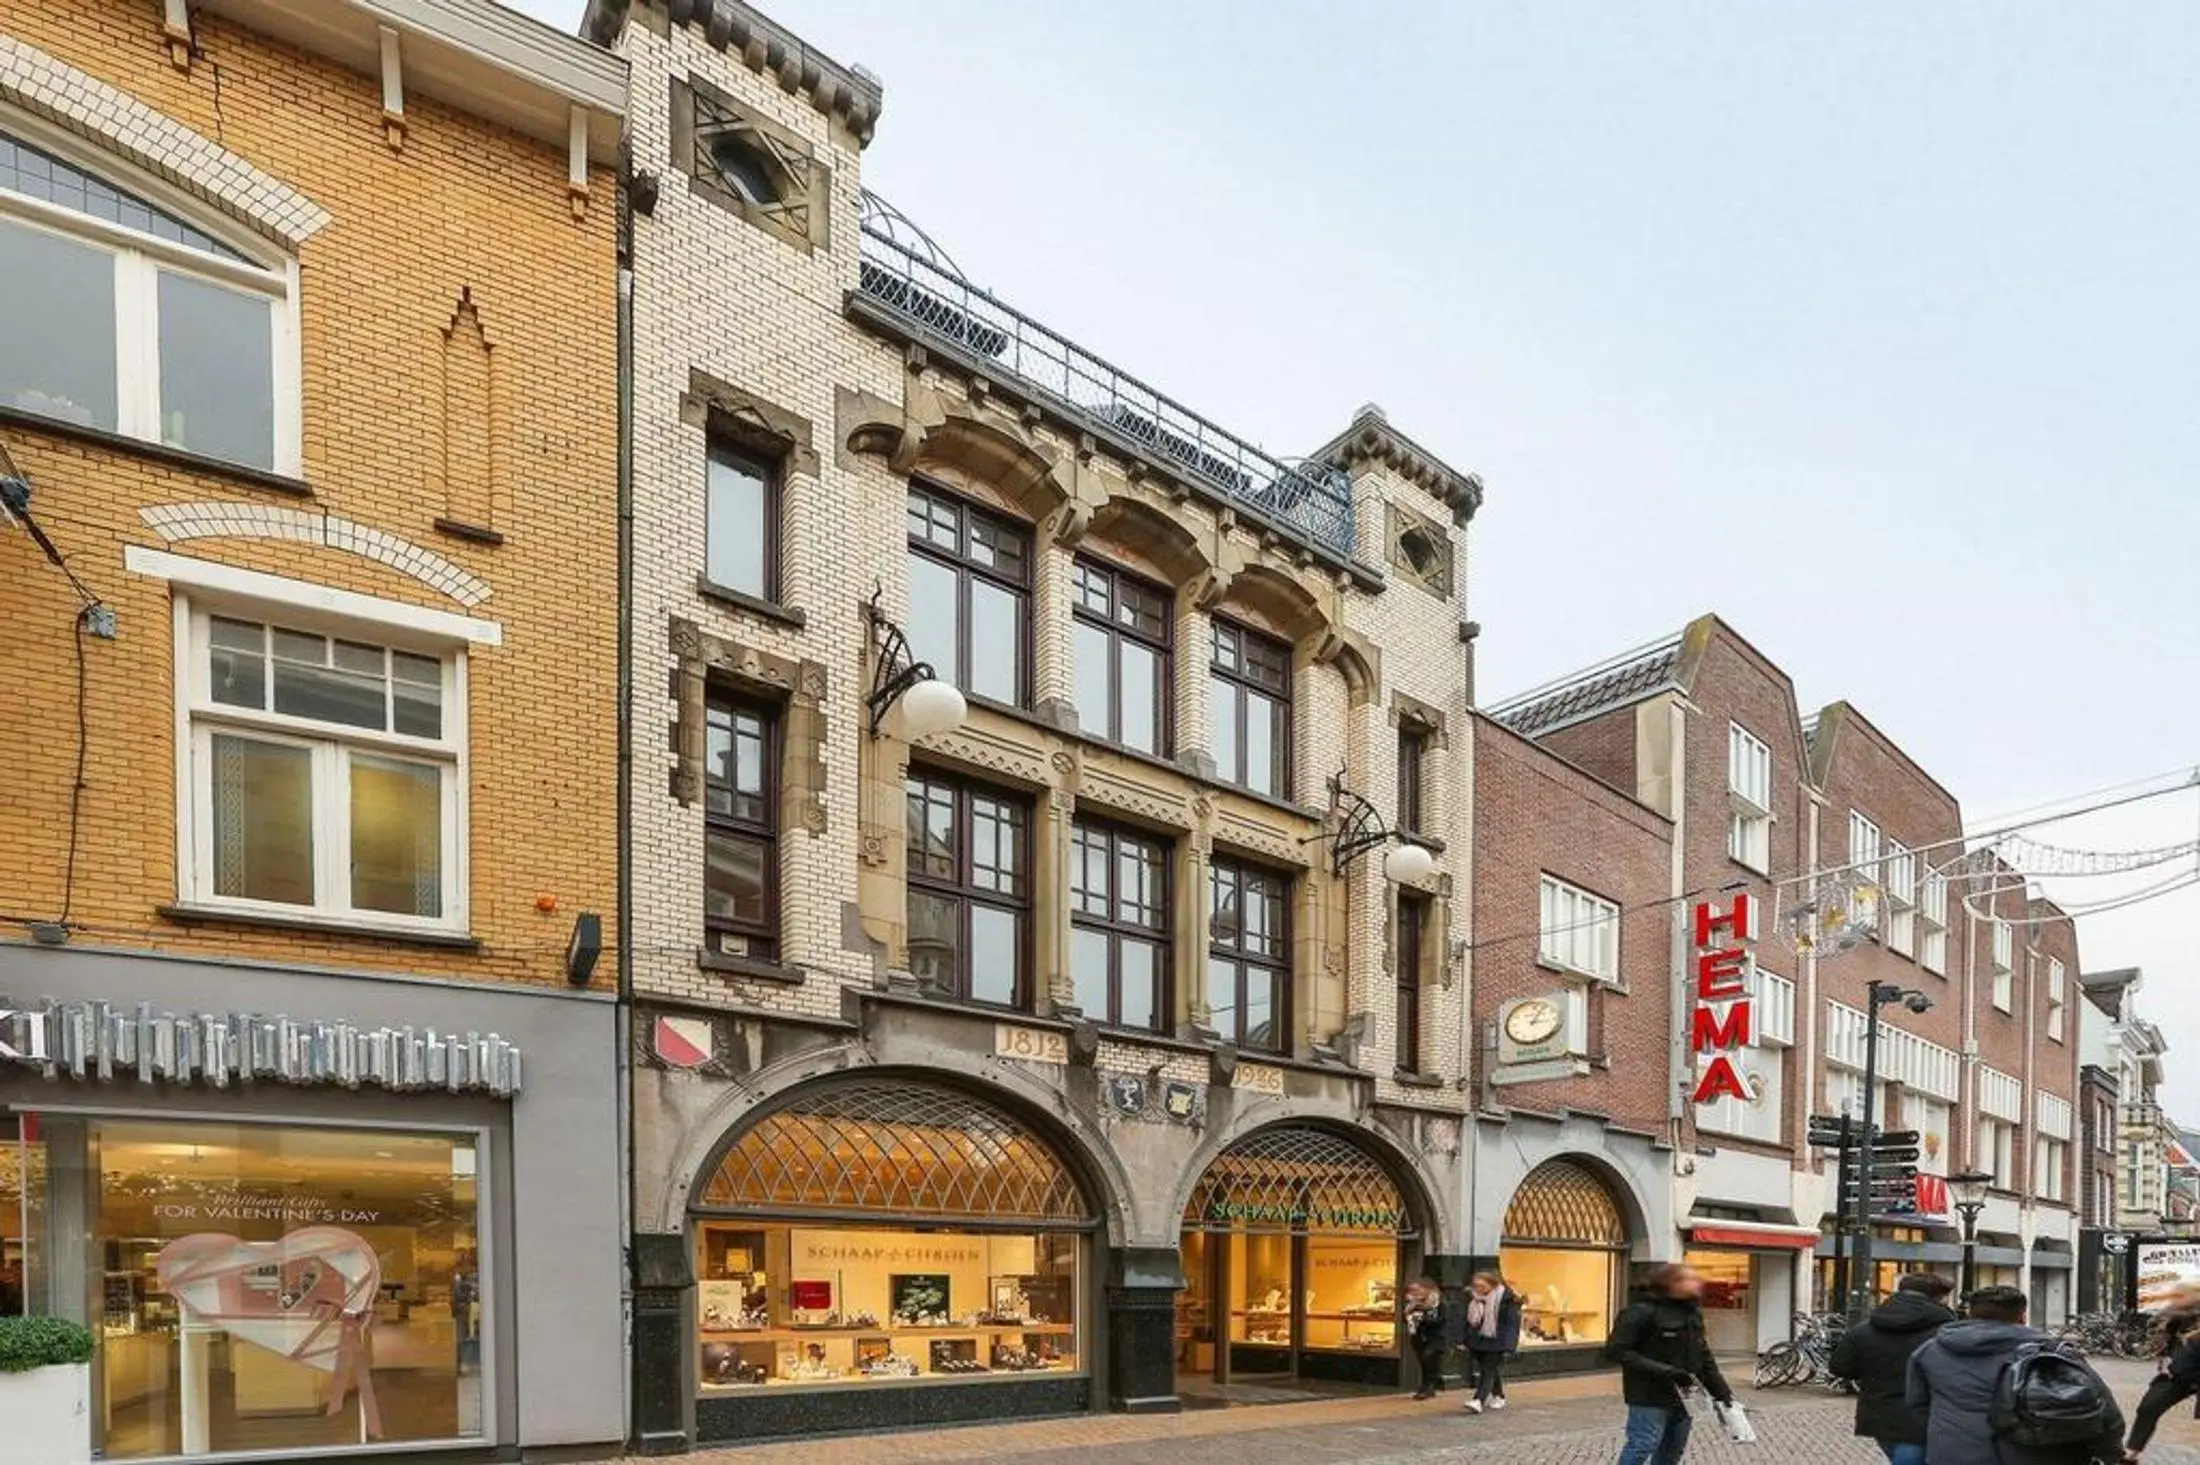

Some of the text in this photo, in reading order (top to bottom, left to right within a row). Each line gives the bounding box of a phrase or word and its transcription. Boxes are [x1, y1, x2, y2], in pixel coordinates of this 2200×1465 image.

[1692, 893, 1758, 1103] HEMA
[1000, 1028, 1065, 1059] 1812
[153, 1204, 380, 1223] FOR VALENTINE'S DAY
[1213, 1203, 1299, 1222] SCHAAP
[807, 1245, 884, 1264] SCHAAP
